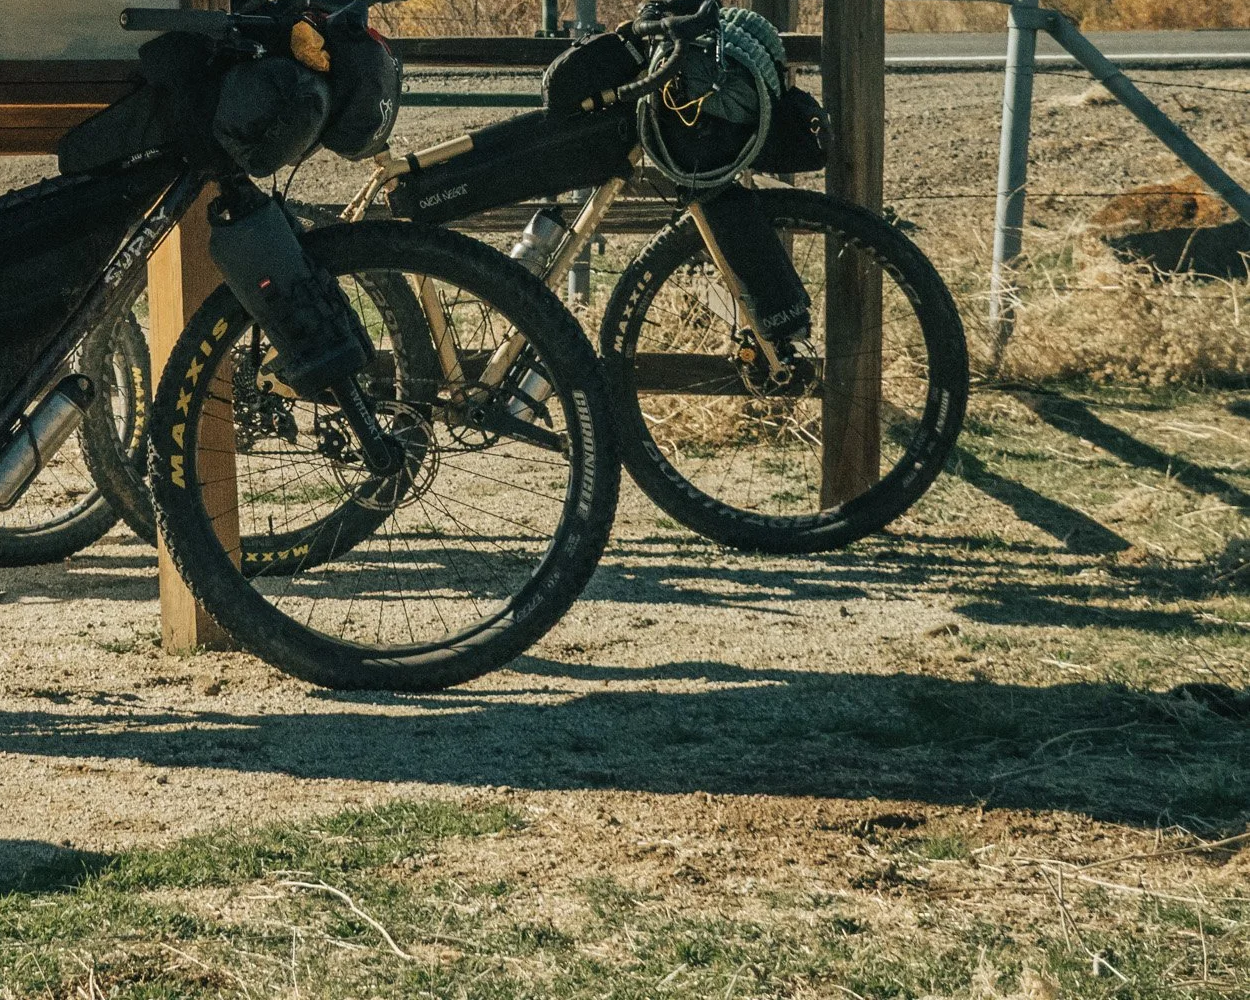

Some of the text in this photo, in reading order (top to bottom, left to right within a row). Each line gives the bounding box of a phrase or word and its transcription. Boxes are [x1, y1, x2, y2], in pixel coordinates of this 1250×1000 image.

[613, 270, 653, 354] MAXXIS
[132, 366, 144, 449] MAXXIS
[170, 317, 228, 489] MAXXIS
[350, 387, 382, 441] WHISKY
[571, 390, 596, 519] CHRONICLE
[240, 544, 309, 562] MAXX
